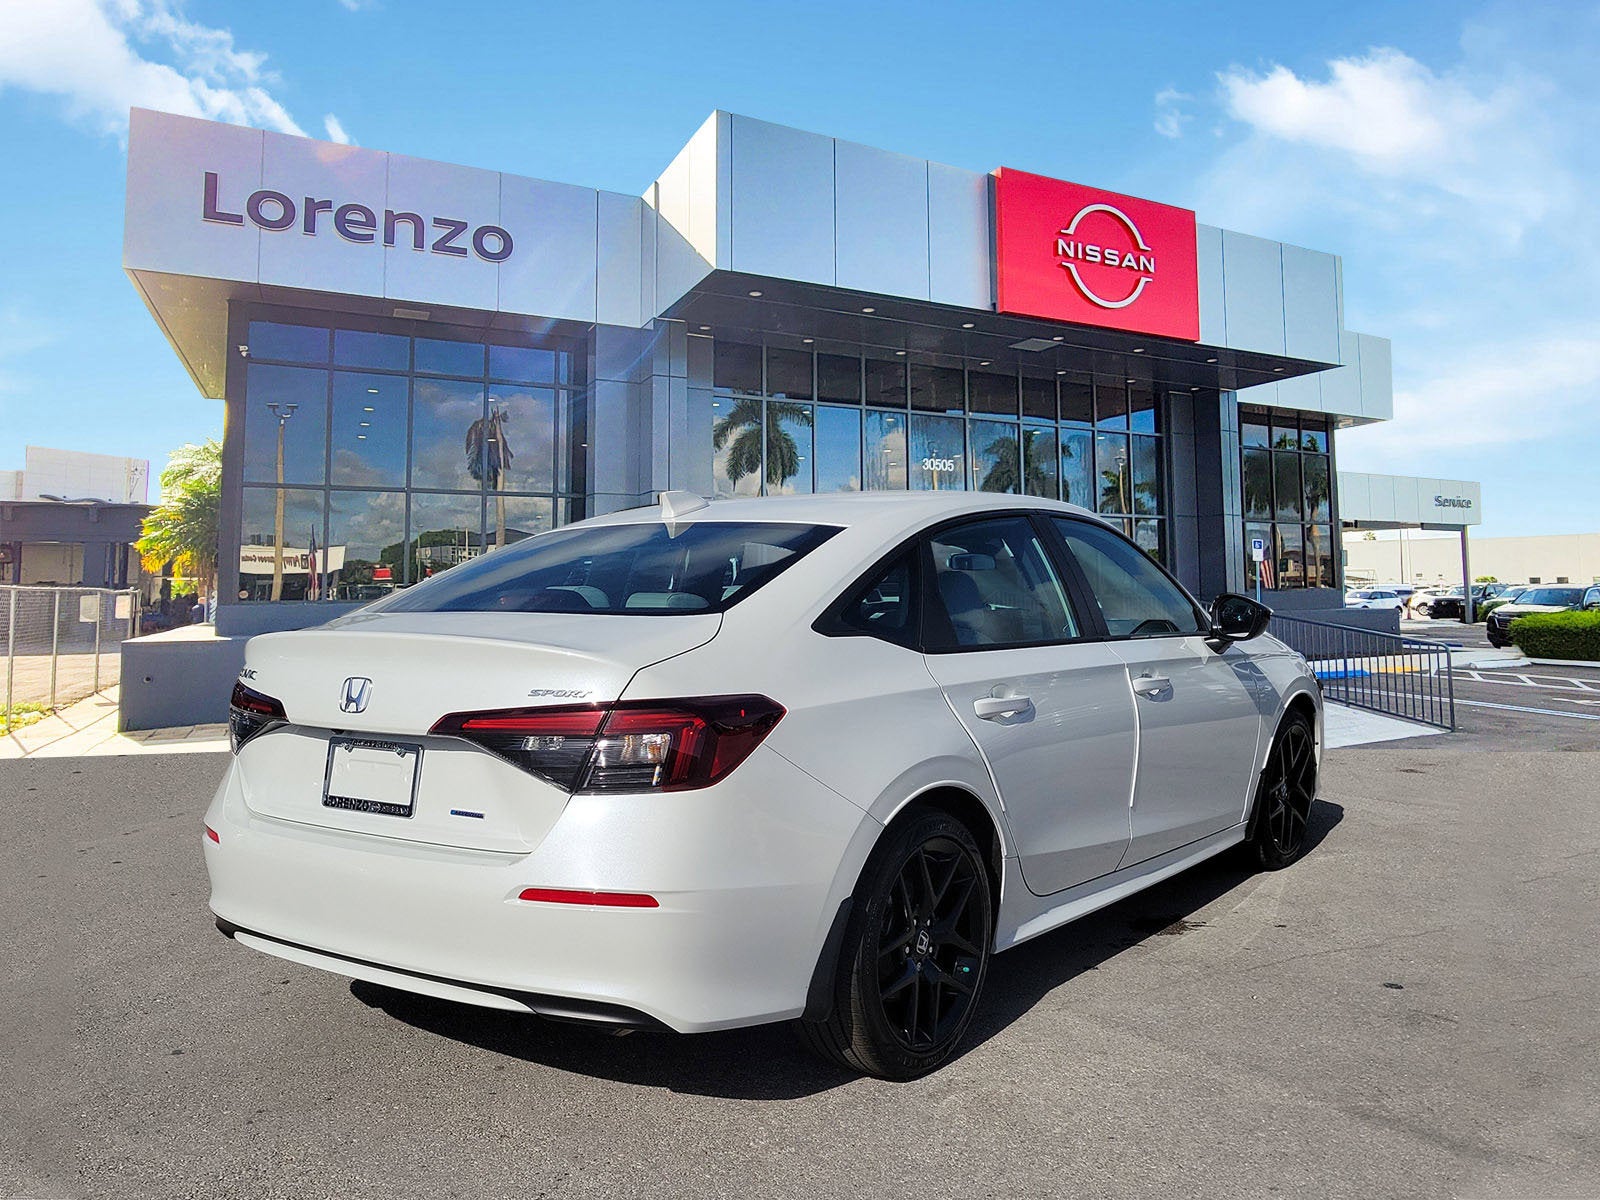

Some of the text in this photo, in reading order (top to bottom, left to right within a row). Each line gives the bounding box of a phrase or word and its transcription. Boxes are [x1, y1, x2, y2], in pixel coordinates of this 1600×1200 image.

[202, 171, 514, 263] Lorenzo
[1057, 238, 1155, 273] NISSAN
[922, 458, 954, 471] 30505
[1434, 495, 1471, 508] Service
[527, 689, 593, 699] SPORT
